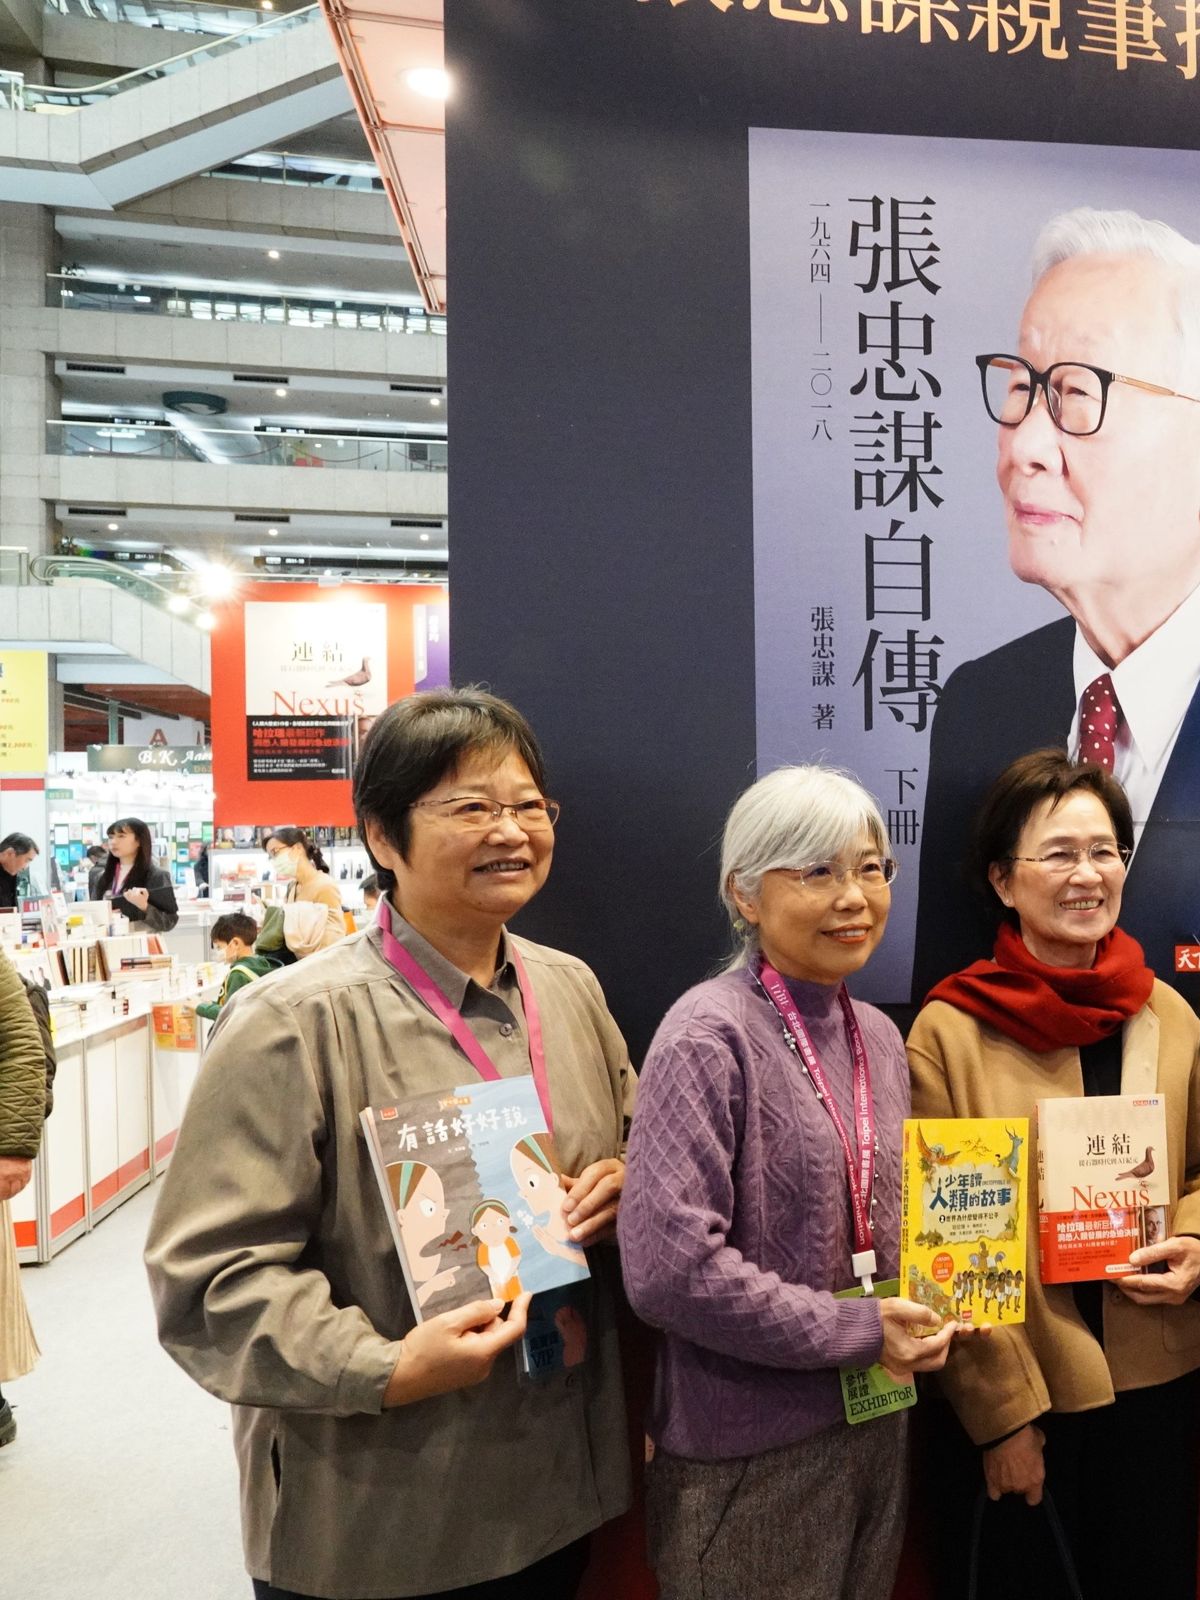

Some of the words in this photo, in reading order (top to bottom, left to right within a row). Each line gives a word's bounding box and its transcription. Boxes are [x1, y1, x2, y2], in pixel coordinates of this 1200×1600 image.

[847, 194, 945, 733] 張忠謀自傳
[810, 605, 836, 688] 張忠謀
[272, 689, 366, 716] Nexus
[810, 703, 835, 731] 著
[883, 766, 920, 846] 下冊
[858, 1056, 873, 1116] International
[397, 1105, 528, 1153] 有話好好說
[861, 1116, 873, 1147] Taipei
[1086, 1133, 1131, 1156] 連結
[813, 1066, 831, 1097] Taipei
[828, 1098, 852, 1162] International
[848, 1163, 858, 1191] Book
[853, 1193, 866, 1246] Exhibition
[929, 1177, 1012, 1213] 人類的故事
[944, 1172, 983, 1189] 少年讀
[1071, 1185, 1151, 1211] Nexus
